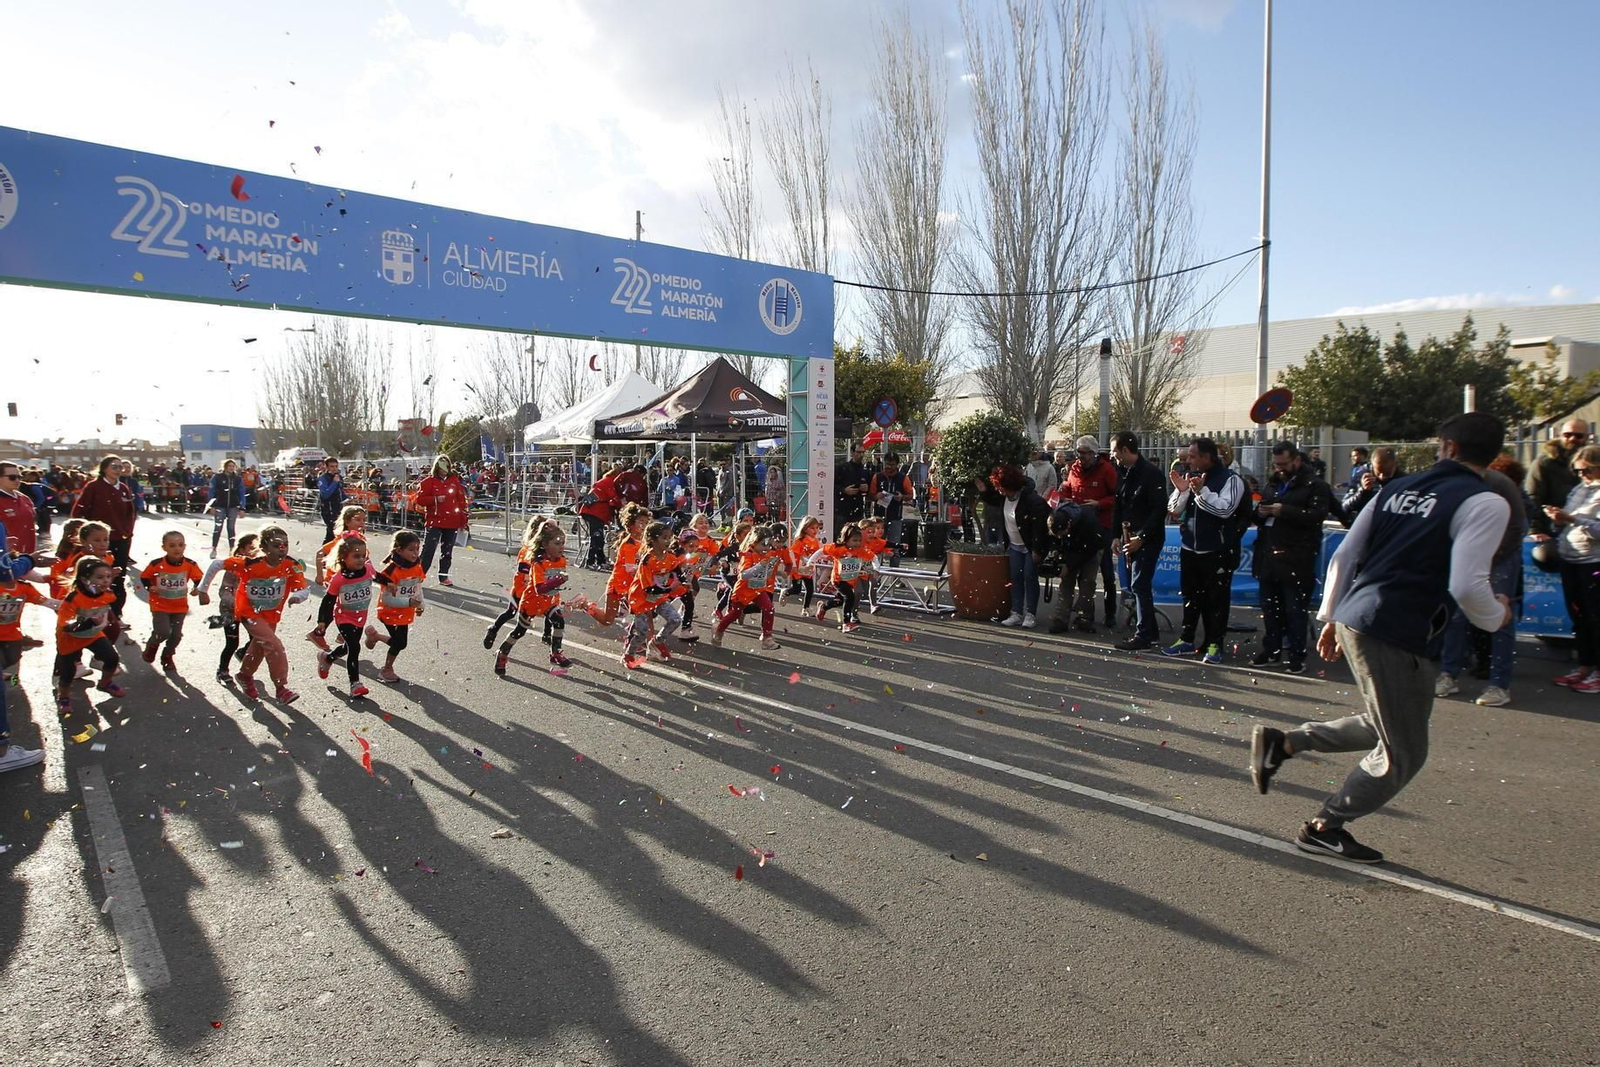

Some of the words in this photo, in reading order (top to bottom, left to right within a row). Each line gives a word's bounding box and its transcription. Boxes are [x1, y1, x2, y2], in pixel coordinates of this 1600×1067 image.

[204, 203, 280, 229] MEDIO
[206, 224, 319, 256] MARATÓN
[206, 246, 308, 273] ALMERÍA
[442, 242, 564, 281] ALMERÍA
[442, 270, 507, 292] CIUDAD
[661, 274, 702, 291] MEDIO
[661, 289, 722, 309] MARATÓN
[661, 305, 717, 322] ALMERÍA
[160, 579, 185, 588] 8346
[250, 585, 282, 596] 8301
[344, 587, 371, 601] 8438
